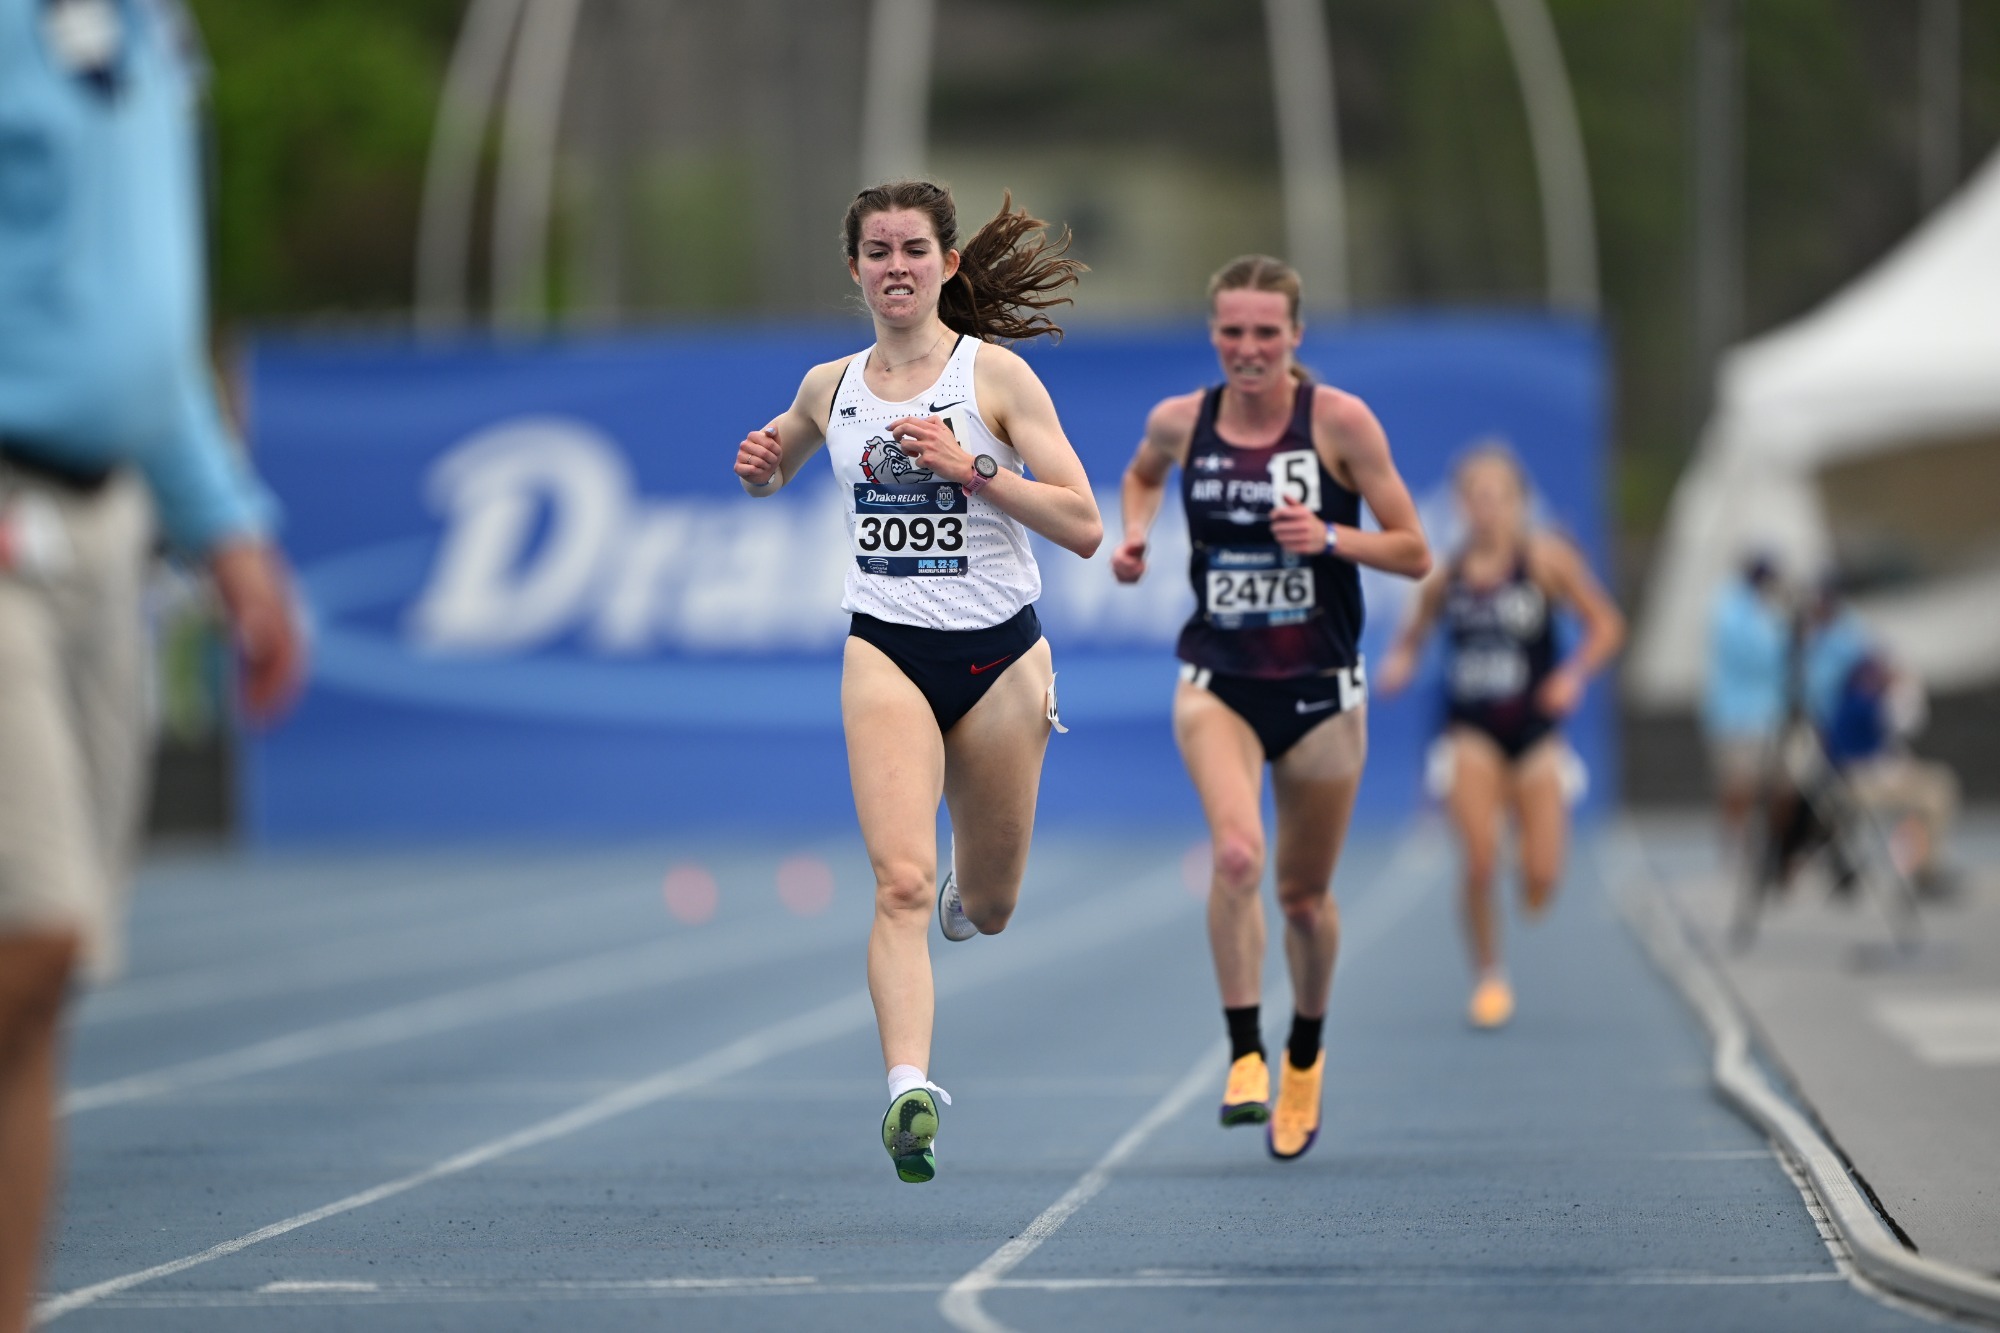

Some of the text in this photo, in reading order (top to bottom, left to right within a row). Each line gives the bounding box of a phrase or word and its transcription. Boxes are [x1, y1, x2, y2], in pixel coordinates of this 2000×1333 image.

[1191, 479, 1274, 503] AIR FOR
[1286, 458, 1308, 506] 5
[866, 489, 927, 503] Drake RELAYS
[938, 492, 952, 501] 100
[858, 517, 963, 551] 3093
[918, 559, 959, 569] APRIL 22-25
[1215, 569, 1308, 606] 2476
